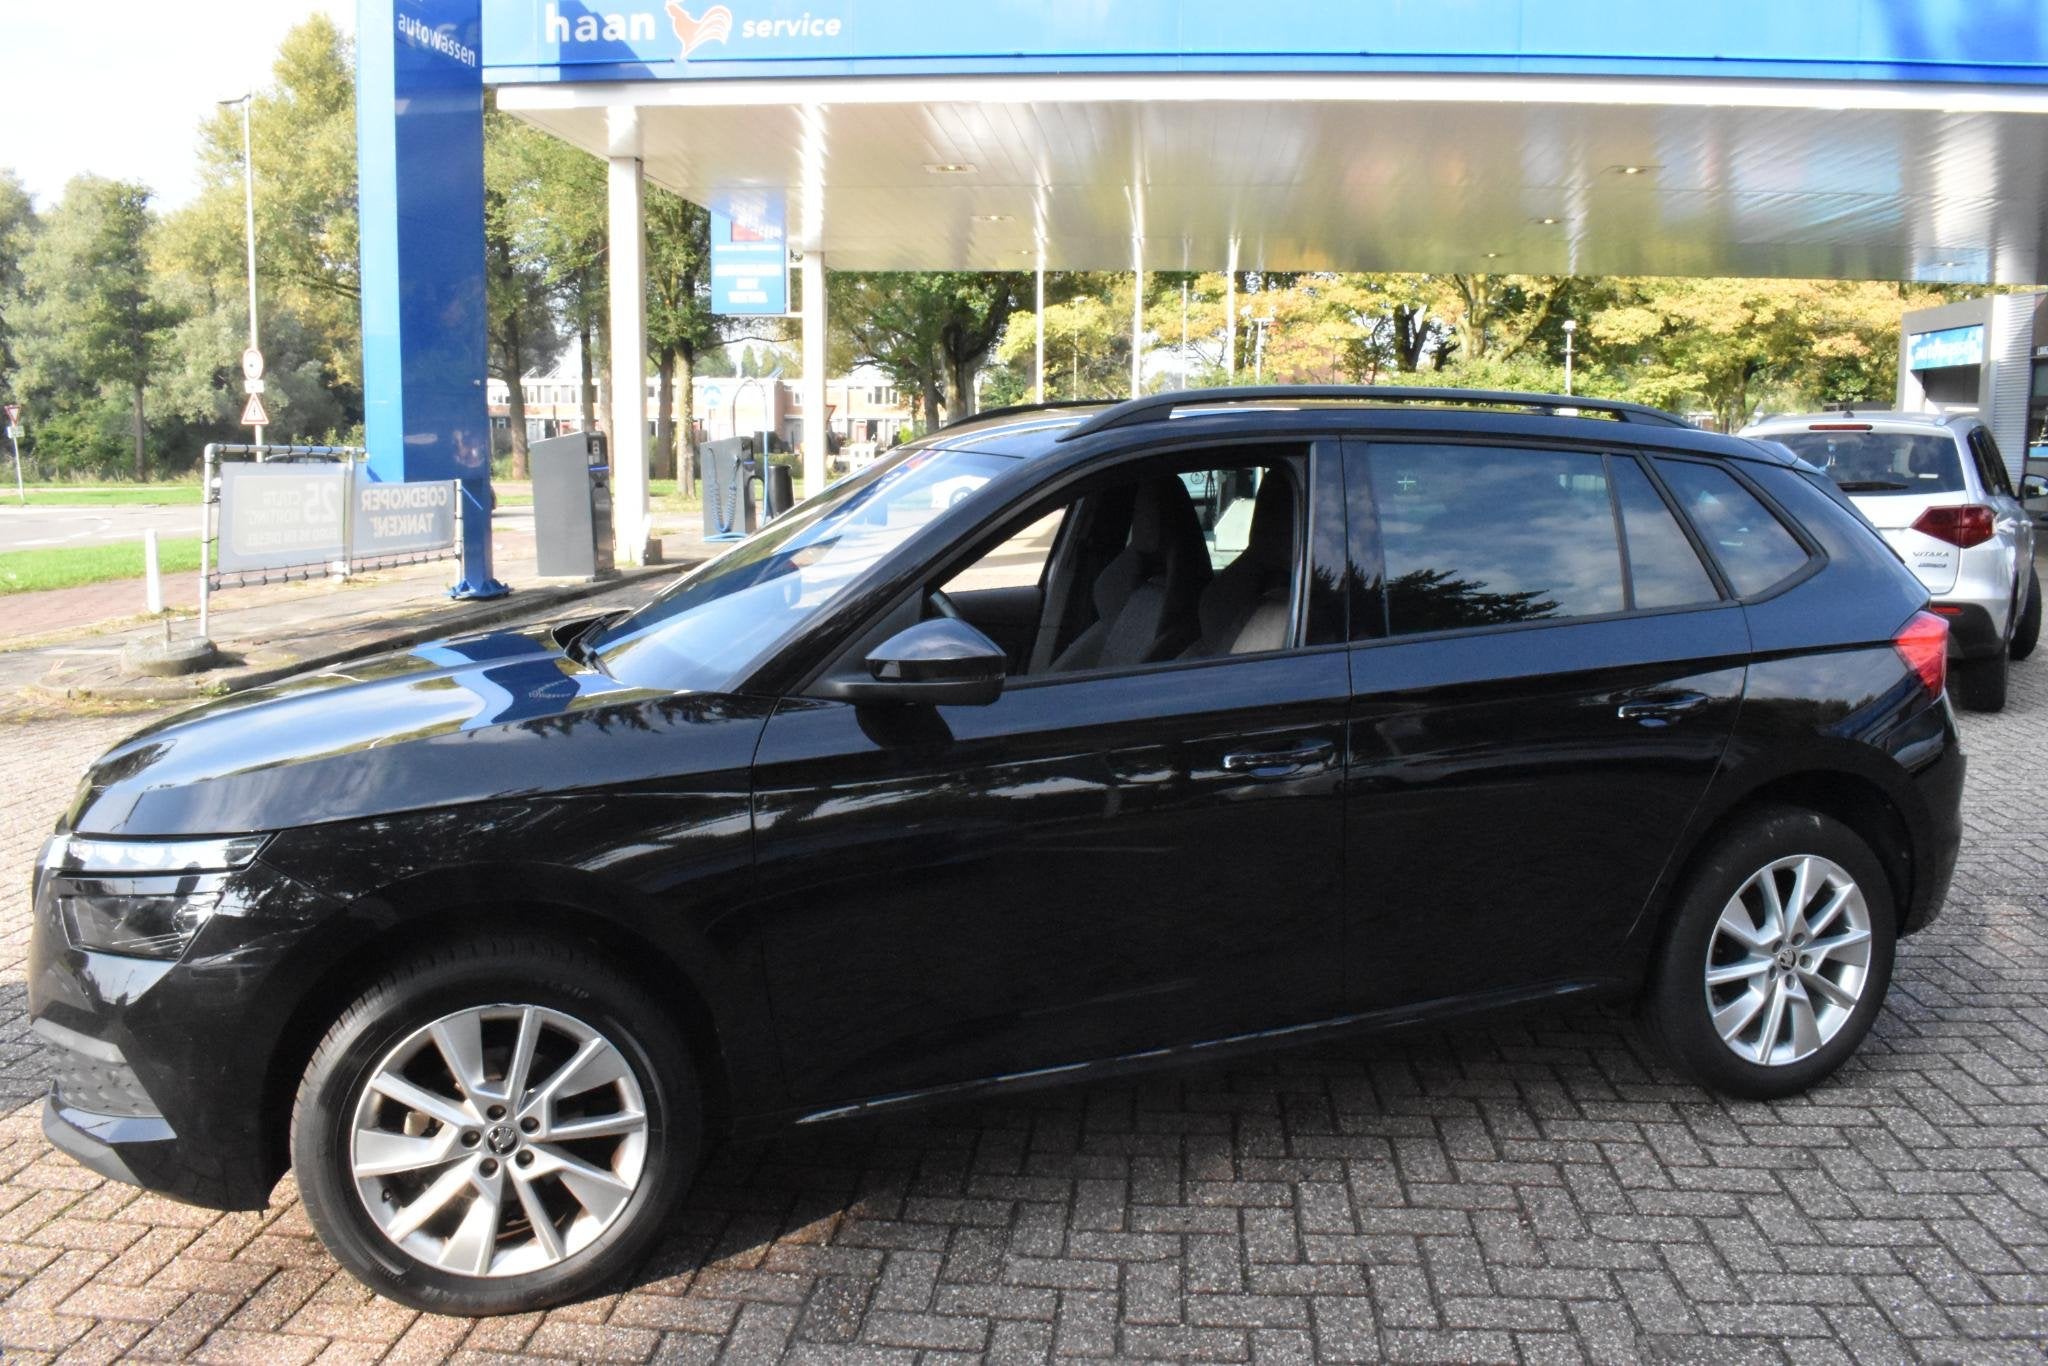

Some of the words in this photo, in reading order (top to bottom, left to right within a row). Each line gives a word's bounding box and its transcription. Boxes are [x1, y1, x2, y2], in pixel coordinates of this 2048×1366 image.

[397, 12, 476, 68] autowassen
[544, 3, 657, 43] haan
[741, 12, 843, 39] service
